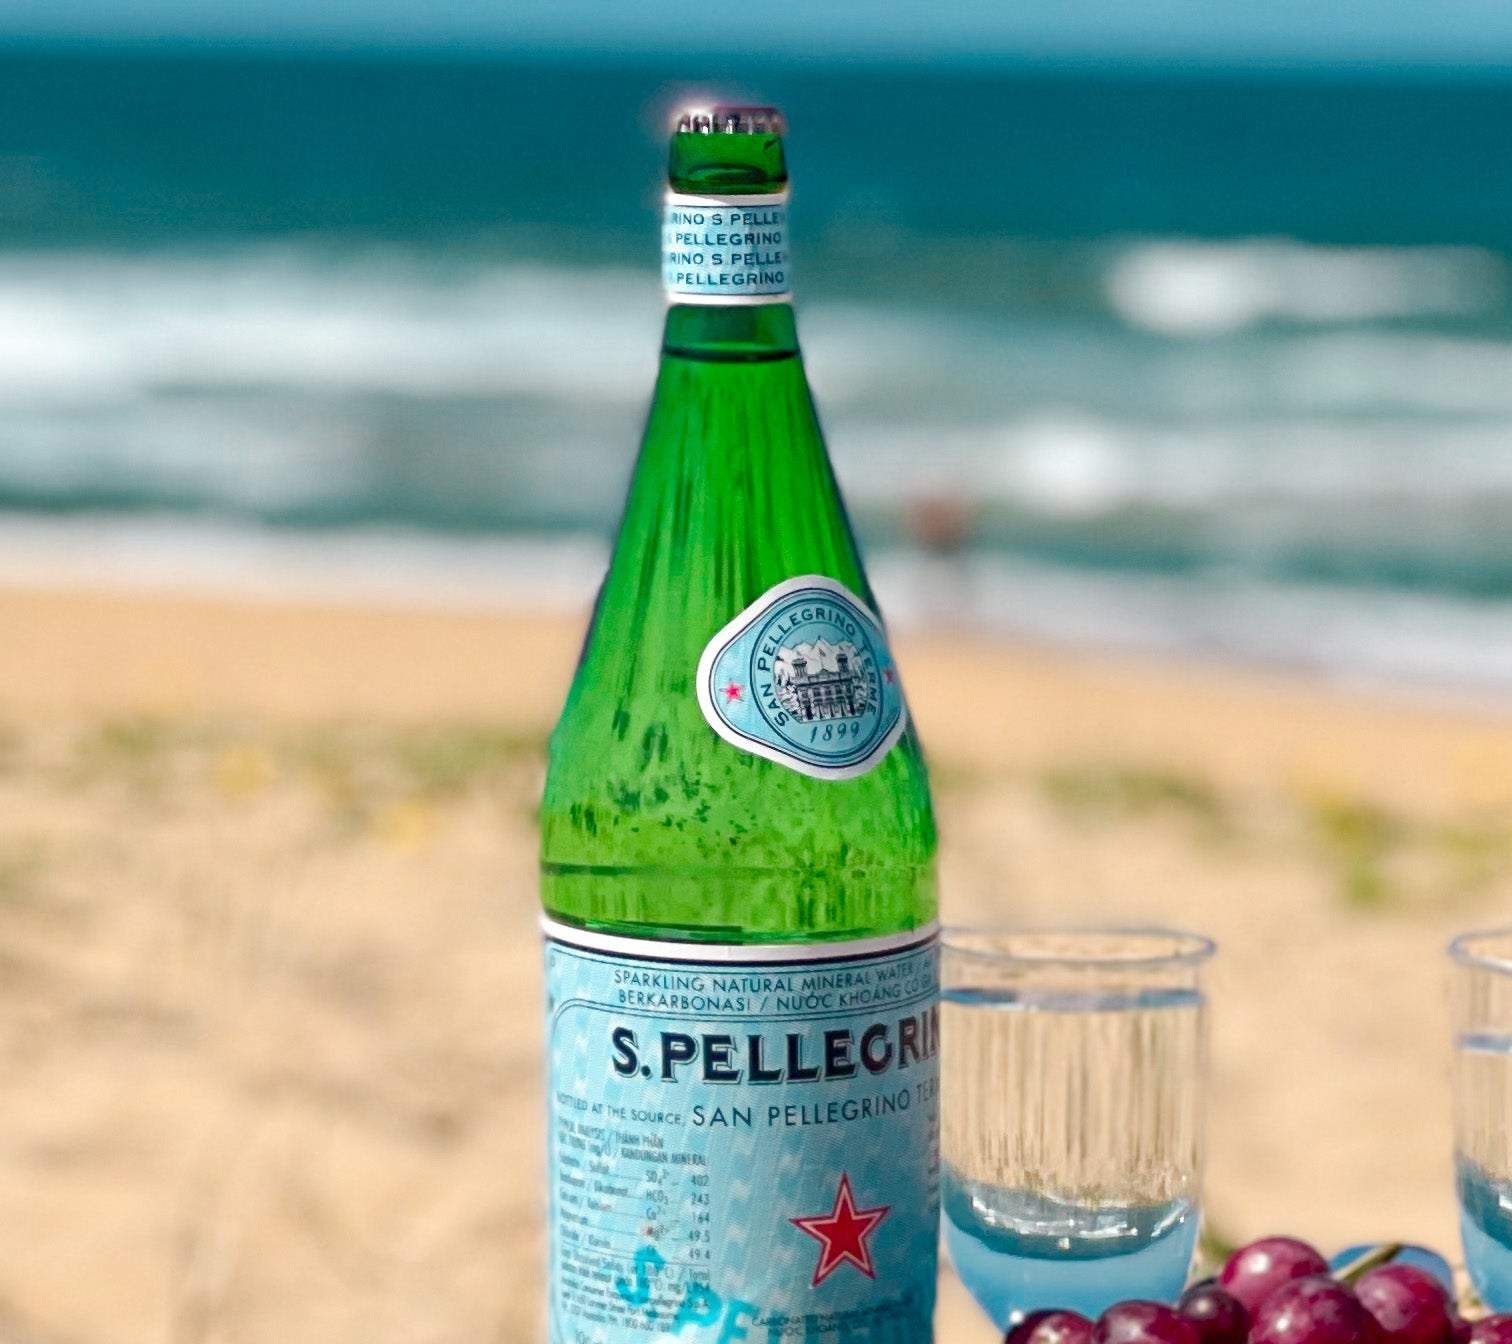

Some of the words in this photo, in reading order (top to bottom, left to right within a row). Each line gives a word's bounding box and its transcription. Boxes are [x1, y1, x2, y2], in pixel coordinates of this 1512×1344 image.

[712, 213, 723, 225] S
[676, 231, 782, 246] PELLEGRINO
[712, 252, 723, 265] S
[677, 271, 785, 286] PELLEGRINO
[757, 607, 857, 672] PELLEGRINO
[761, 684, 789, 727] SAN
[810, 721, 860, 744] 1899
[614, 969, 705, 992] SPARKLING
[713, 978, 793, 994] NATURAL
[802, 973, 870, 992] MINERAL
[876, 961, 913, 984] WATER
[619, 988, 750, 1012] BERKARBONASI
[607, 1104, 626, 1119] THE
[631, 1109, 687, 1127] SOURCE,
[693, 1105, 751, 1128] SAN
[768, 1089, 911, 1127] PELLEGRINO
